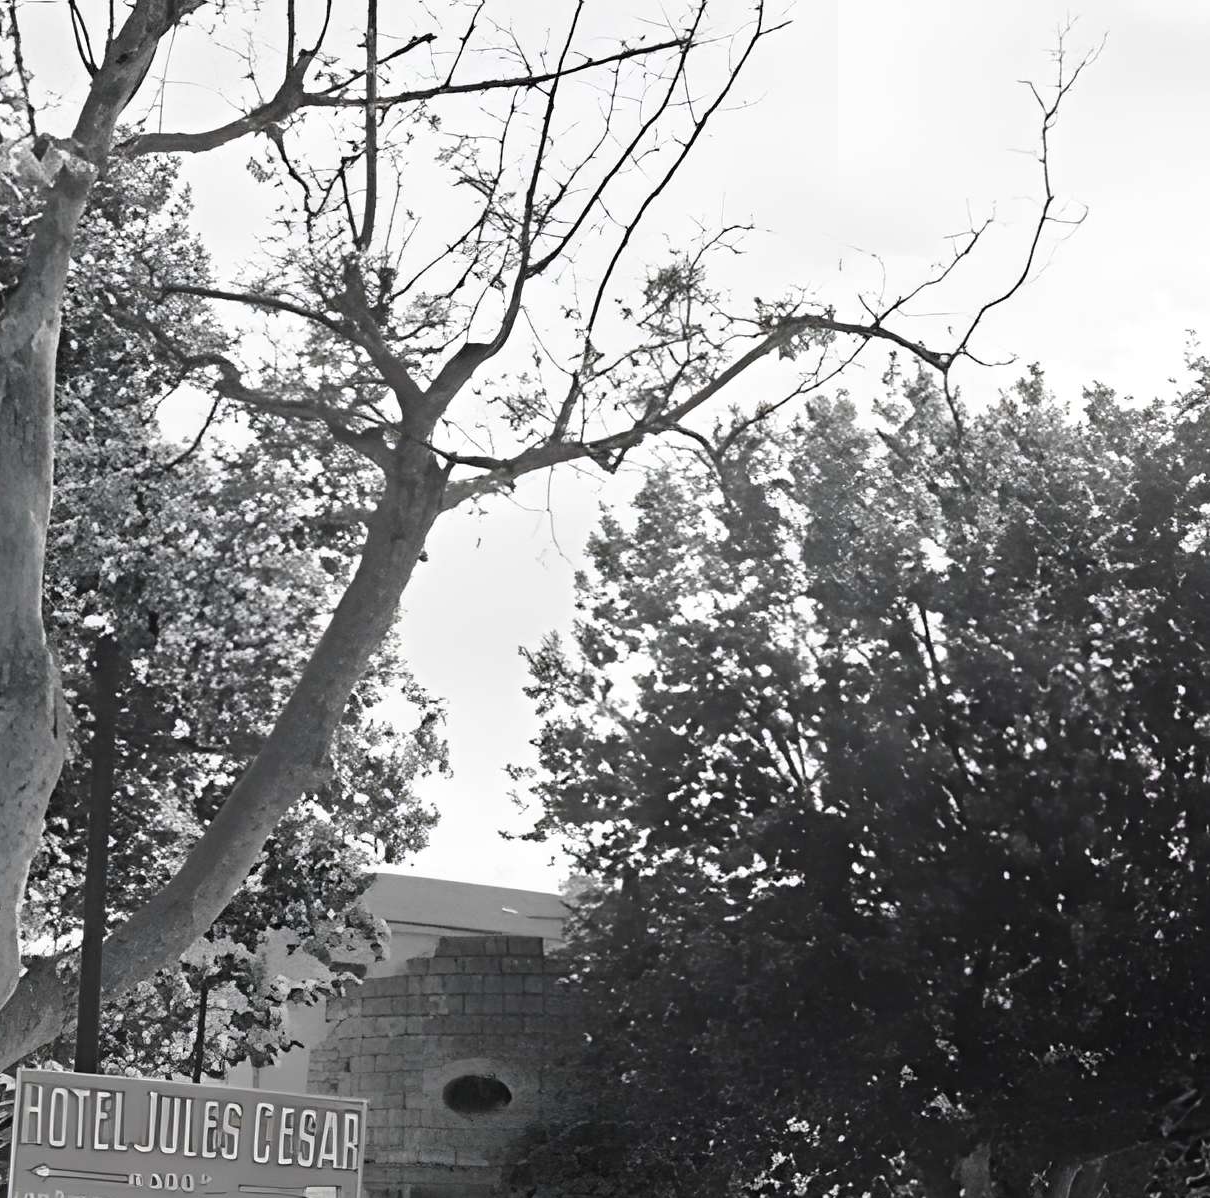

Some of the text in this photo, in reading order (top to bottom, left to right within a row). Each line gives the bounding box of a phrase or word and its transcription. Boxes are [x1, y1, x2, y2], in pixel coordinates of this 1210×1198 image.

[21, 1083, 361, 1171] HOTEL JULES CESAR
